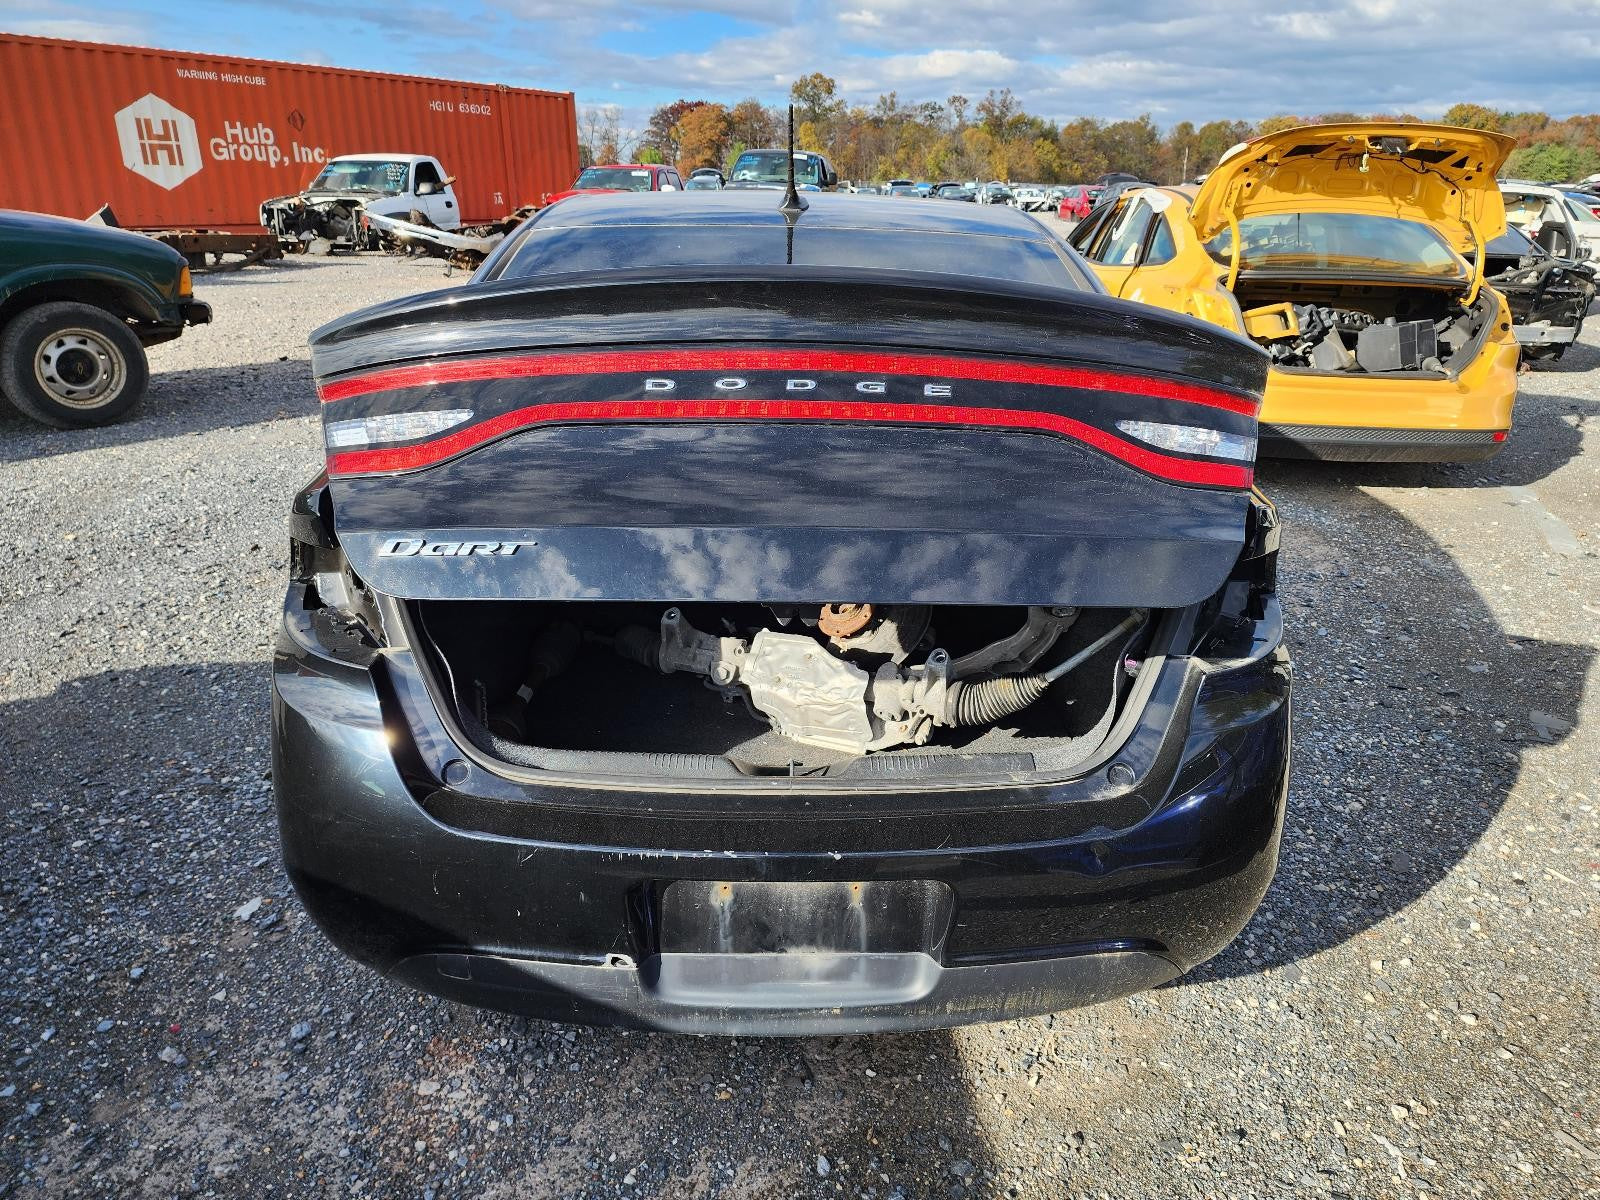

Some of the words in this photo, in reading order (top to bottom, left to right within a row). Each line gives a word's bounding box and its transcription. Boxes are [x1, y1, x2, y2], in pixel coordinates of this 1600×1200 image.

[176, 68, 218, 81] WARNING
[221, 73, 242, 83] HIGH
[244, 75, 267, 85] CUBE
[224, 120, 275, 145] Hub
[209, 137, 289, 168] Group,
[292, 141, 332, 164] Inc.
[645, 378, 951, 397] DODGE
